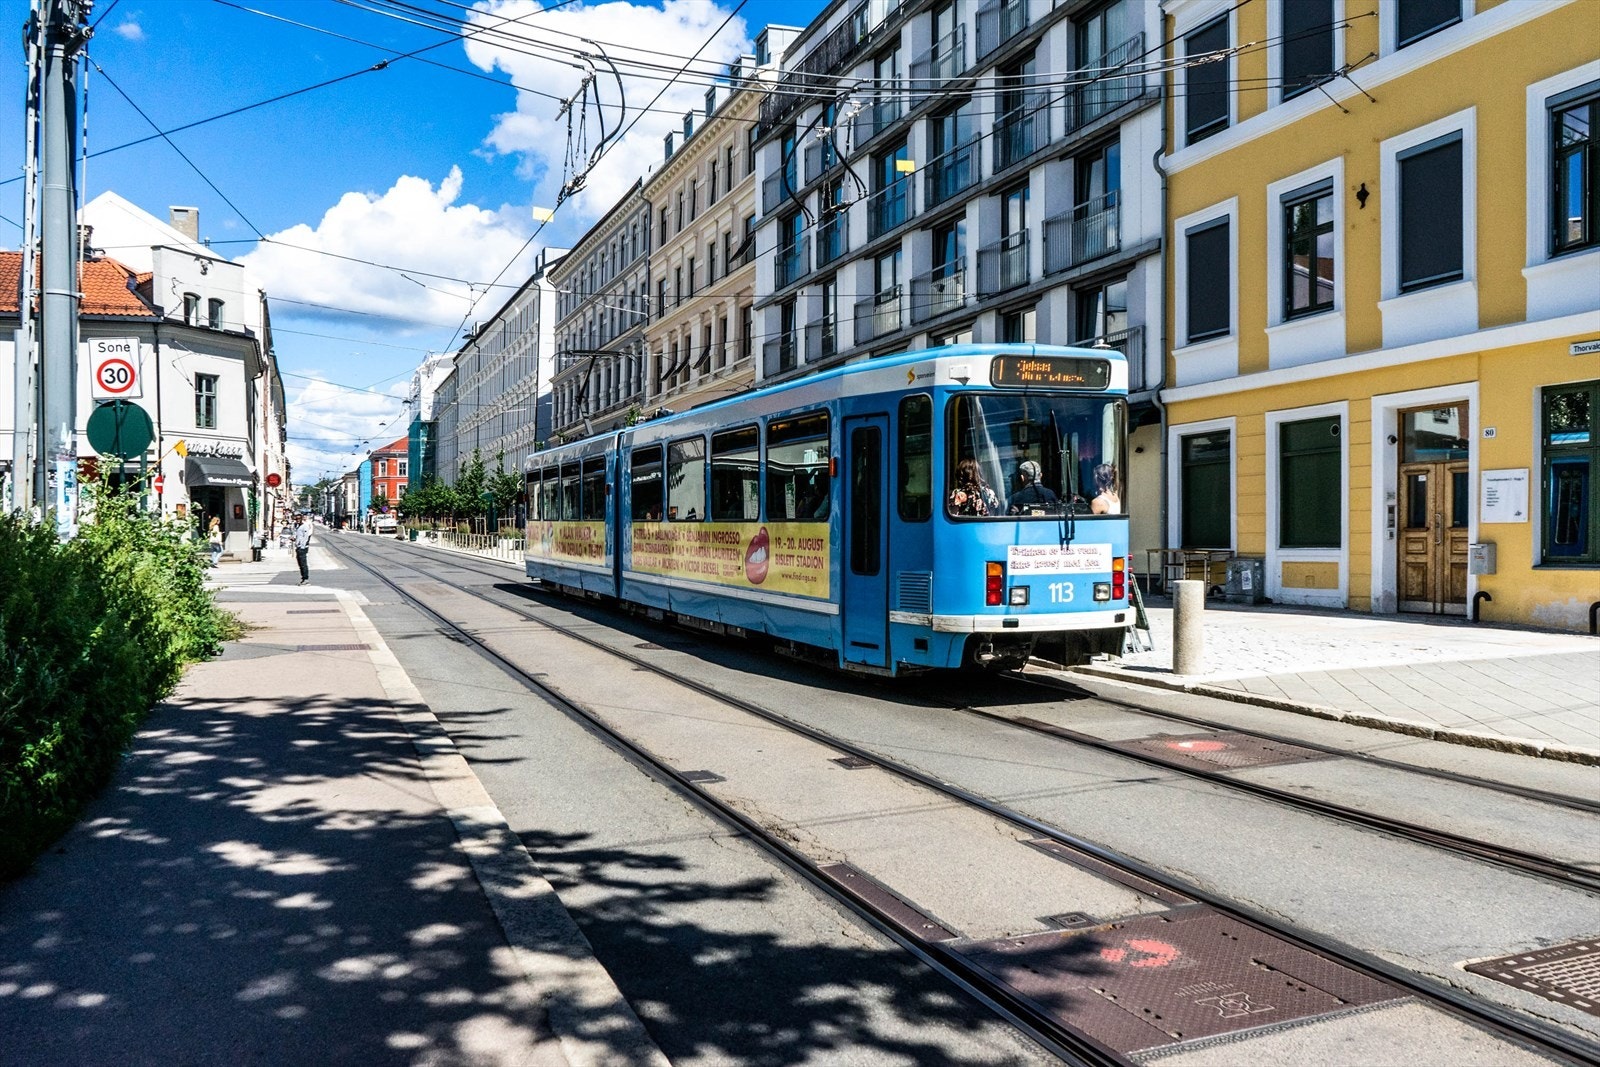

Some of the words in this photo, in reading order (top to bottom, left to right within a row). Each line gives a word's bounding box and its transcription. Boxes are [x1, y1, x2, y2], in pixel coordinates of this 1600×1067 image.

[98, 342, 131, 353] Sone
[104, 367, 129, 385] 30
[1485, 429, 1494, 437] 80
[711, 531, 740, 545] INGROSSO
[797, 538, 824, 551] AUGUST
[775, 553, 795, 567] BISLETT
[796, 555, 824, 569] STADION
[1048, 582, 1074, 603] 113
